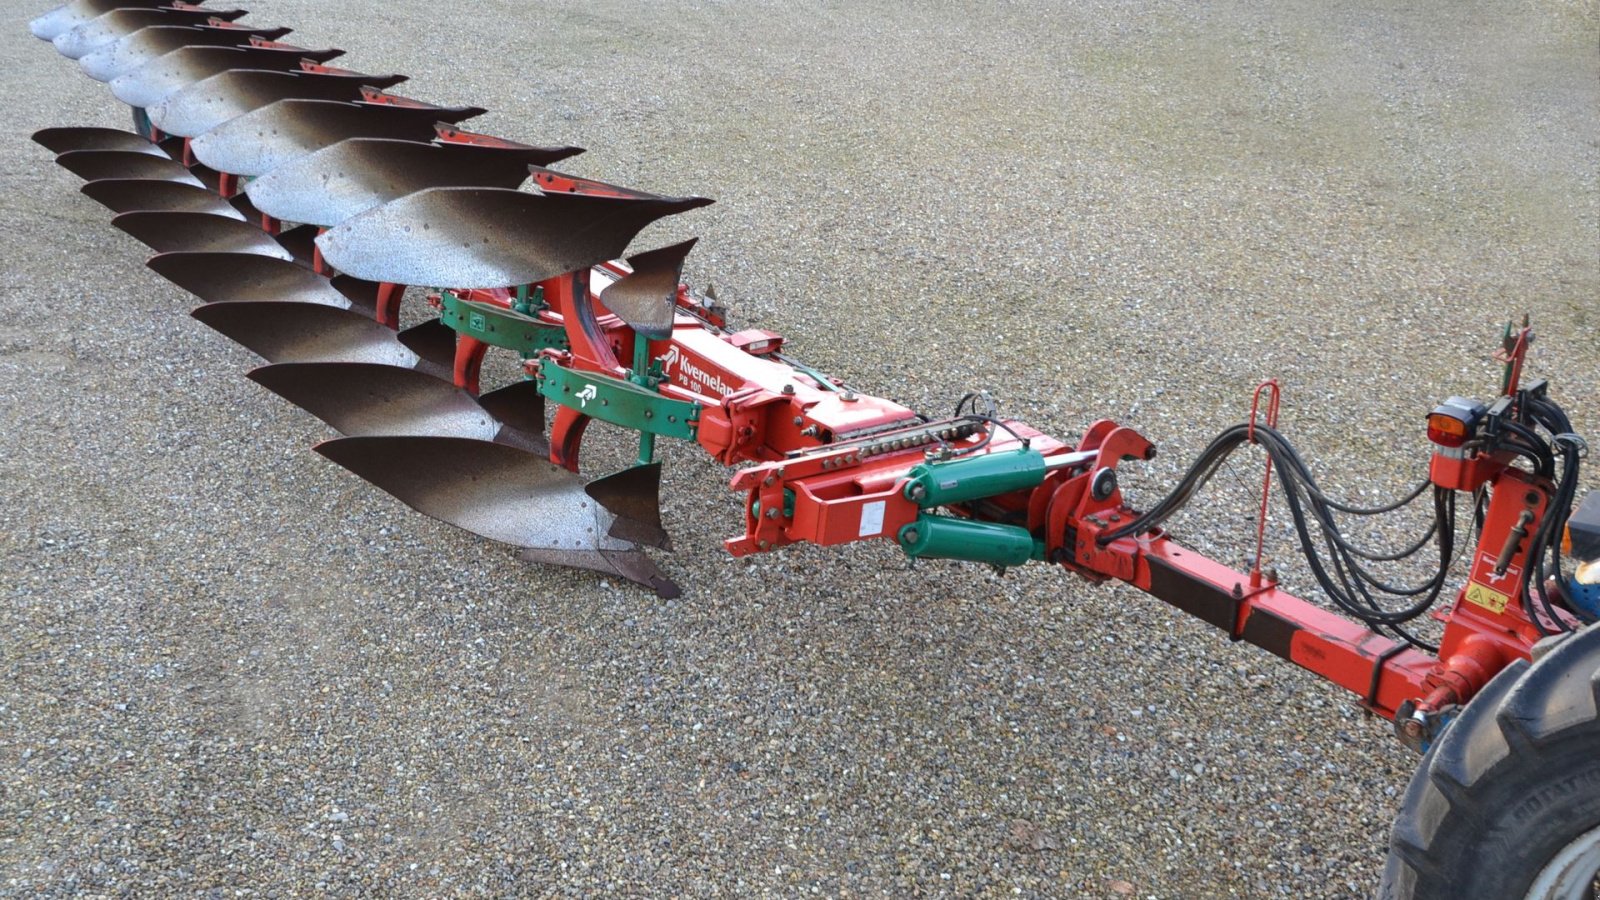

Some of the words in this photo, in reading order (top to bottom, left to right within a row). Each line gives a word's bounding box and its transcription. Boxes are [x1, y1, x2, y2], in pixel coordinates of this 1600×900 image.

[679, 373, 688, 386] PB
[691, 380, 702, 394] 100
[680, 354, 735, 397] Kvernelan
